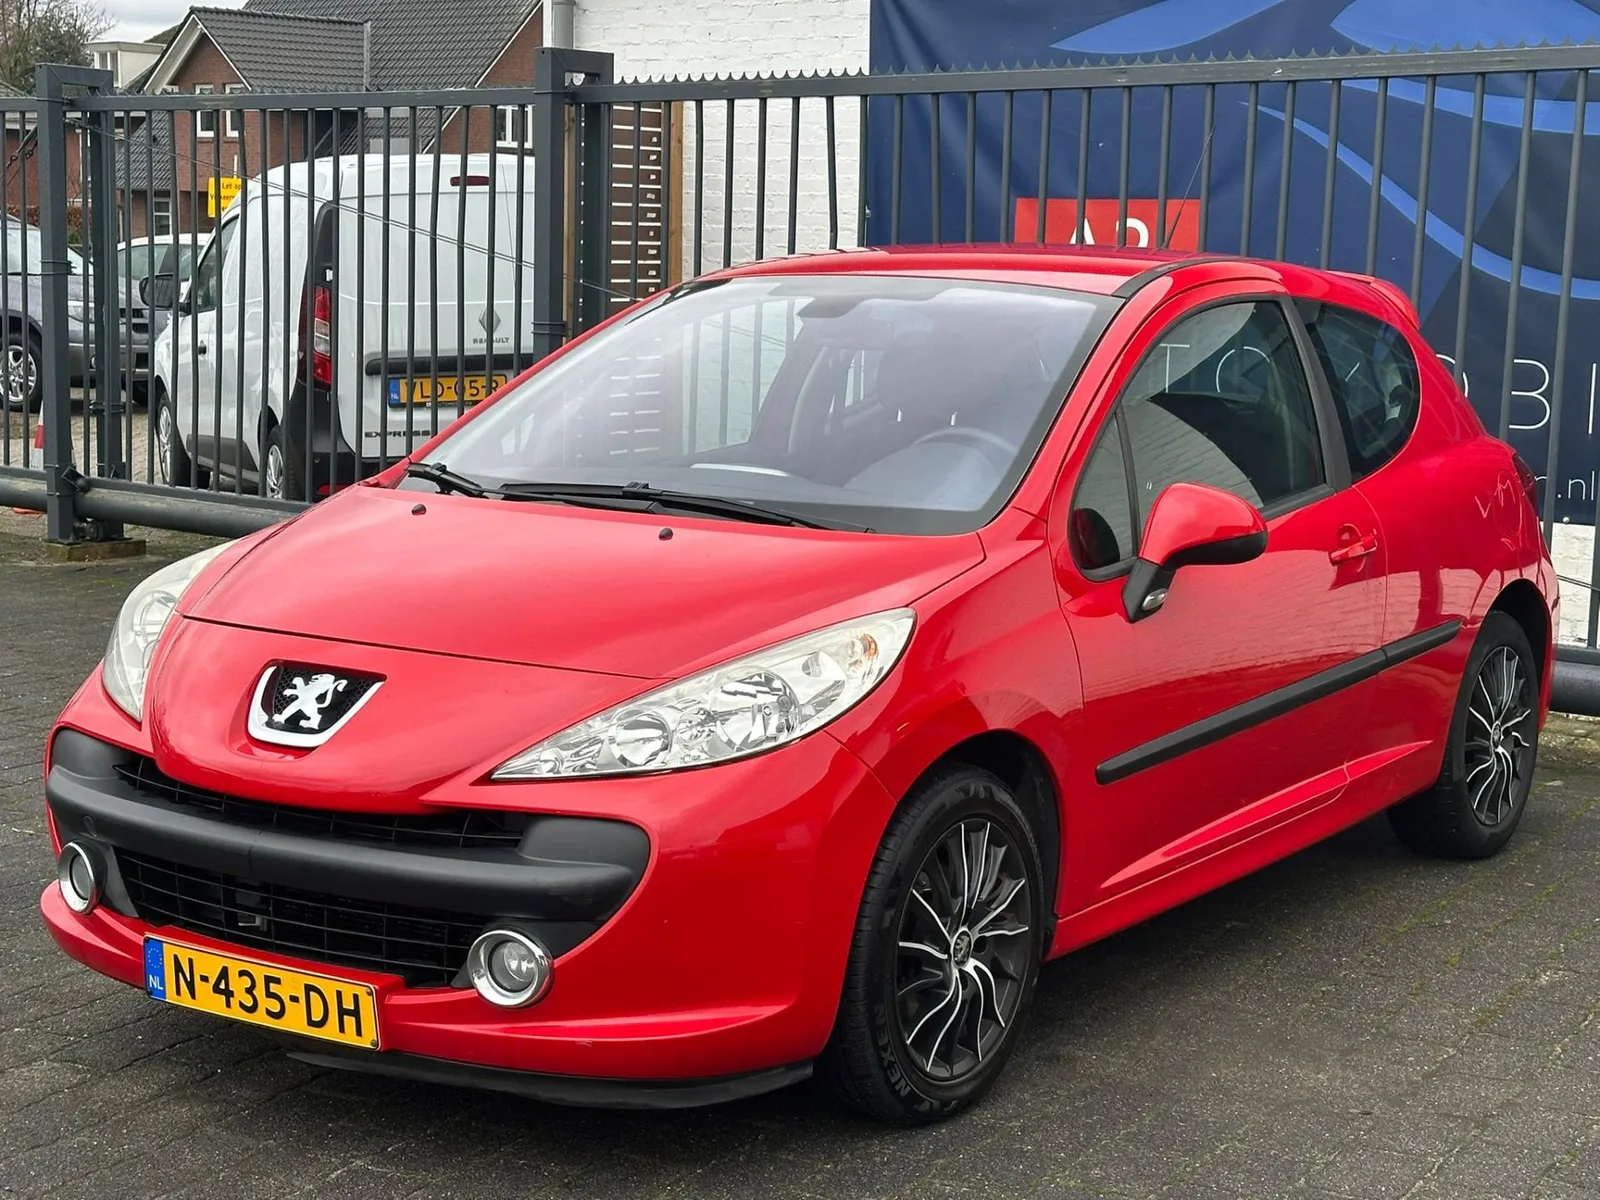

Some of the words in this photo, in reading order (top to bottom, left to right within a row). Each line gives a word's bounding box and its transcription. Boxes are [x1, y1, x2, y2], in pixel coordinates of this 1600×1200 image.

[390, 392, 400, 400] NL
[149, 974, 164, 991] NL
[173, 953, 363, 1037] N-435-DH
[873, 1003, 912, 1098] NEXEN
